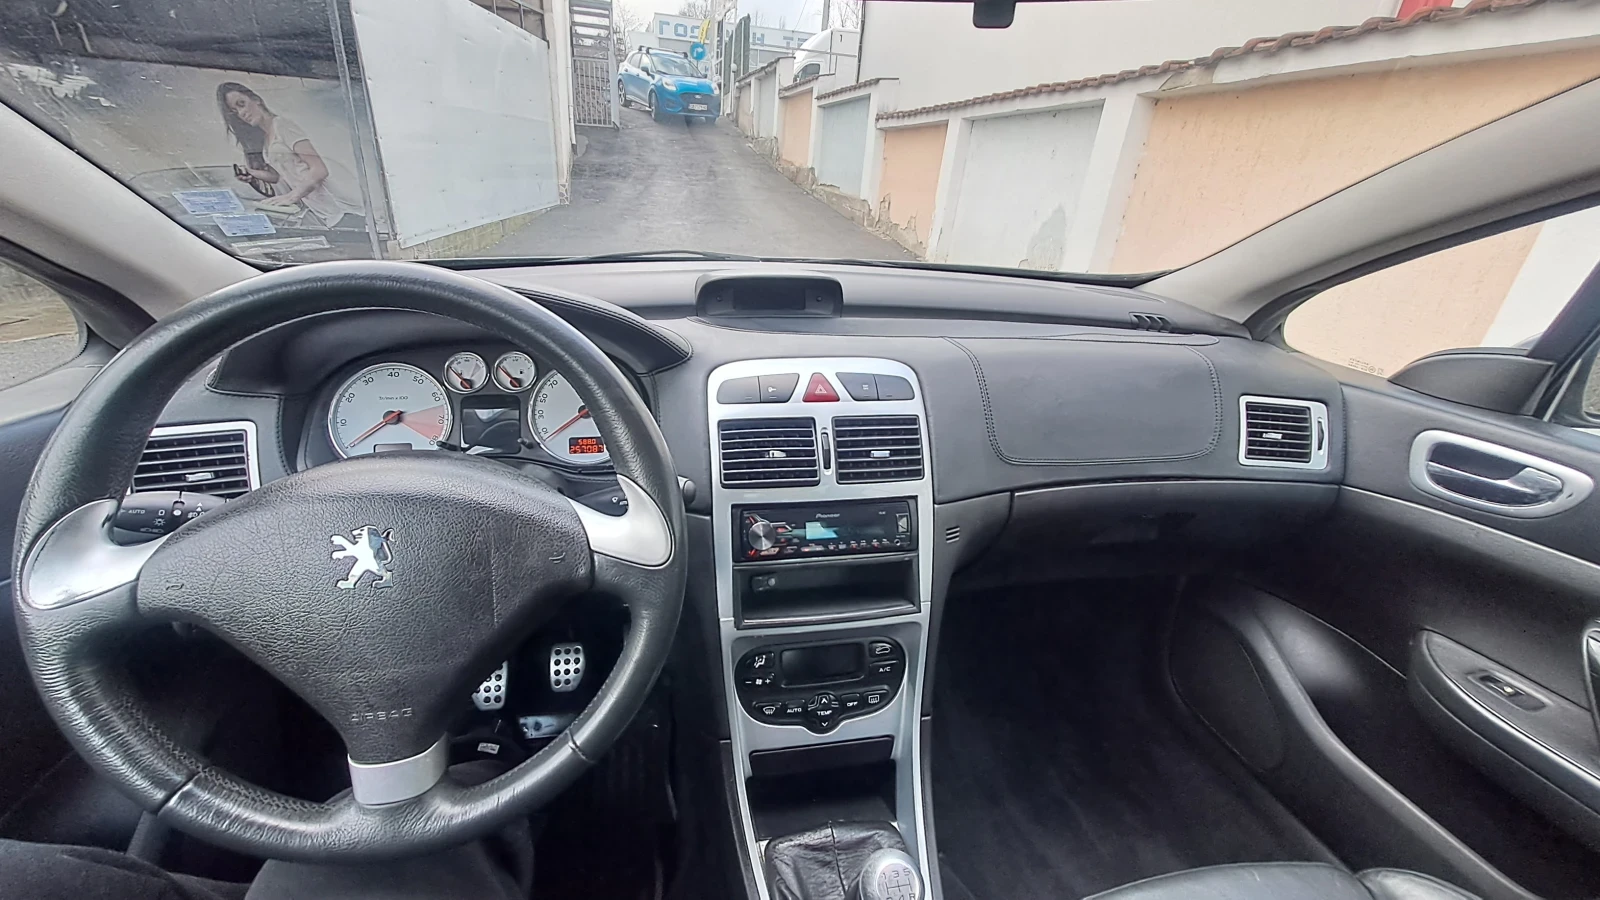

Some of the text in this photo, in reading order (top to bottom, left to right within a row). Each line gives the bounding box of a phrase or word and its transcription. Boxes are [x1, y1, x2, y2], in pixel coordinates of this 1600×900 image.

[362, 376, 374, 386] 30
[412, 375, 425, 385] 50
[548, 379, 559, 389] 70
[345, 392, 355, 403] 20
[431, 391, 441, 402] 60
[540, 393, 548, 403] 50
[538, 409, 544, 419] 30
[340, 418, 347, 427] 10
[438, 414, 445, 425] 70
[542, 427, 549, 435] 10
[429, 435, 439, 446] 80
[569, 444, 604, 454] 257087
[351, 707, 413, 721] AIRBAG
[892, 870, 900, 879] 3
[903, 867, 911, 876] 5
